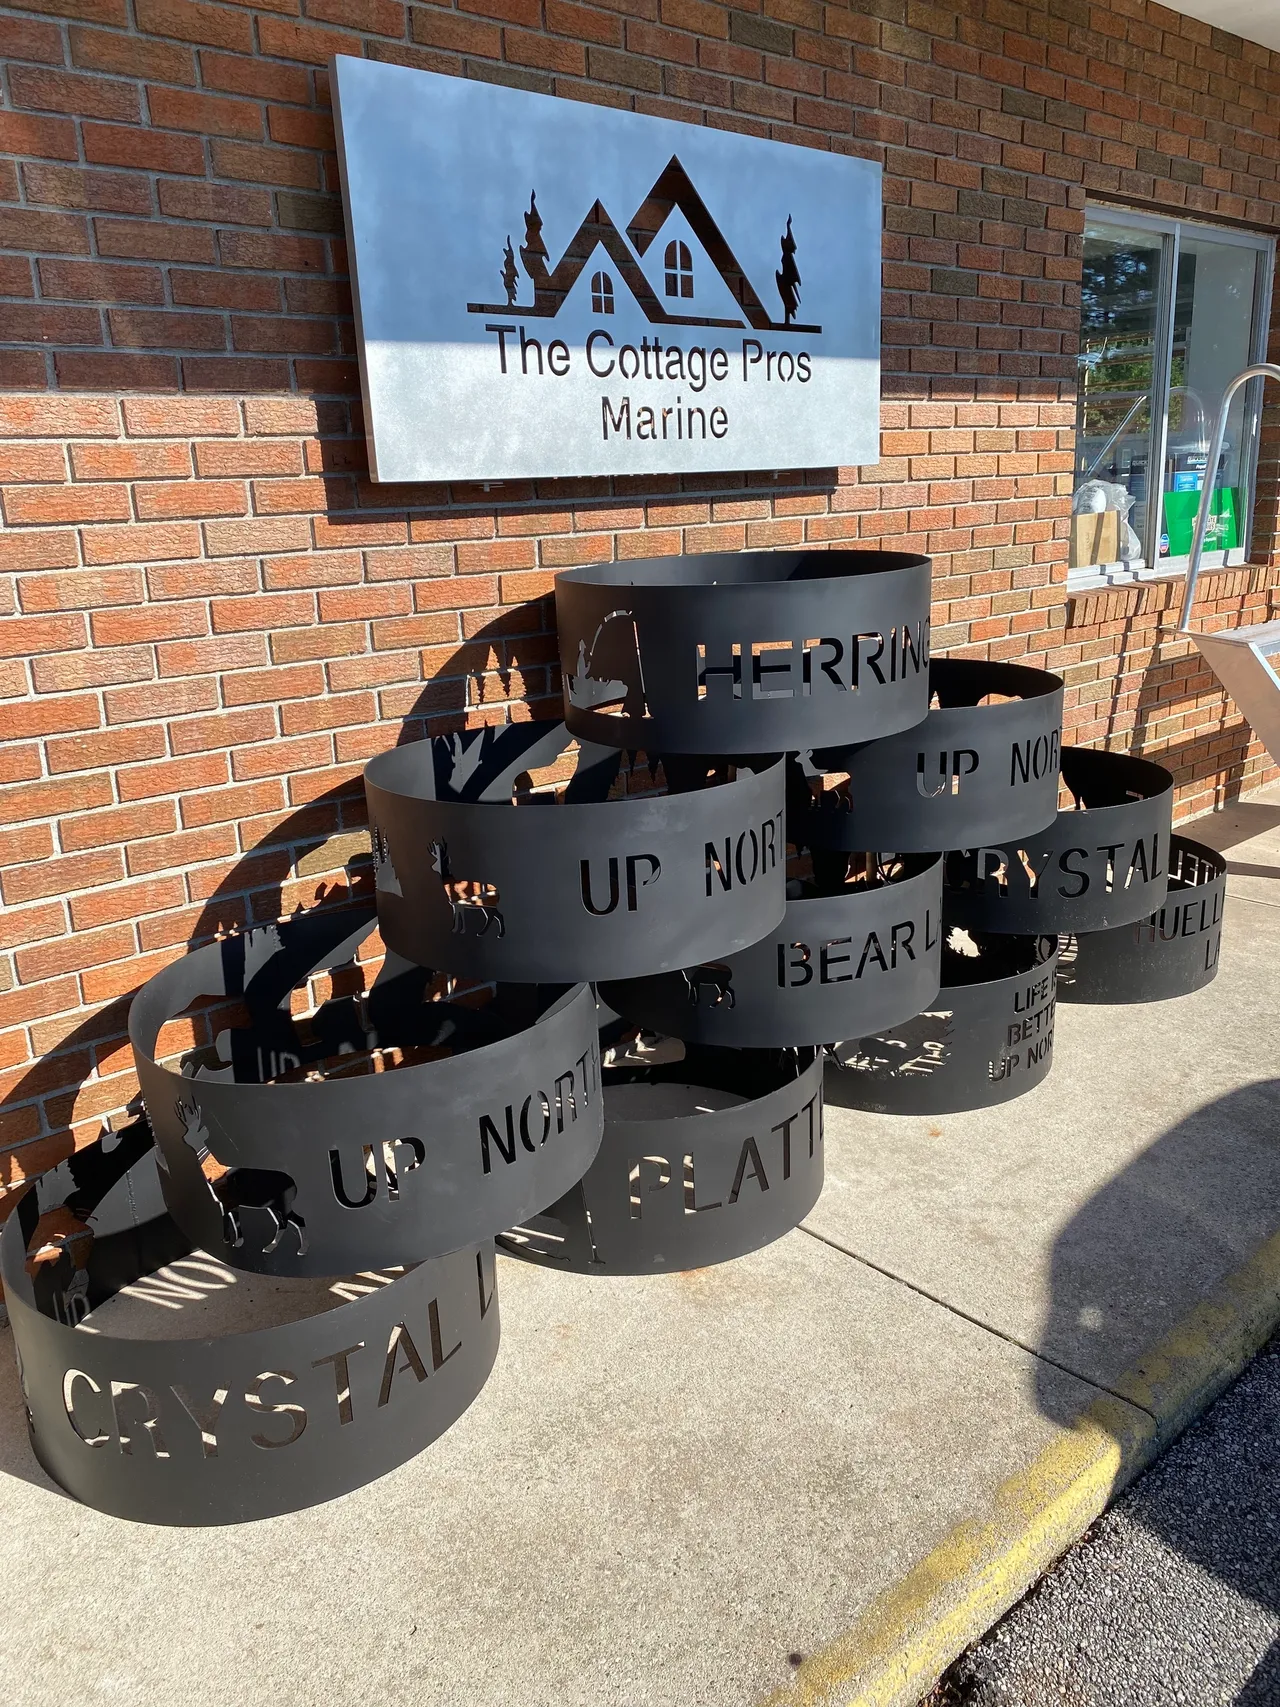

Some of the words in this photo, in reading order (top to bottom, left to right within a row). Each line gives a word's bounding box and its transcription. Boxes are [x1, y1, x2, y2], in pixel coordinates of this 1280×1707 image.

[485, 323, 570, 376] The
[586, 329, 729, 392] Cottage
[742, 338, 812, 383] Pros
[601, 396, 729, 440] Marine
[917, 749, 979, 798] UP
[580, 853, 662, 917] UP
[776, 919, 917, 989] BEAR
[1014, 975, 1049, 1014] LIFE
[988, 1054, 1020, 1082] UP
[328, 1136, 426, 1210] UP
[61, 1297, 463, 1460] CRYSTAL
